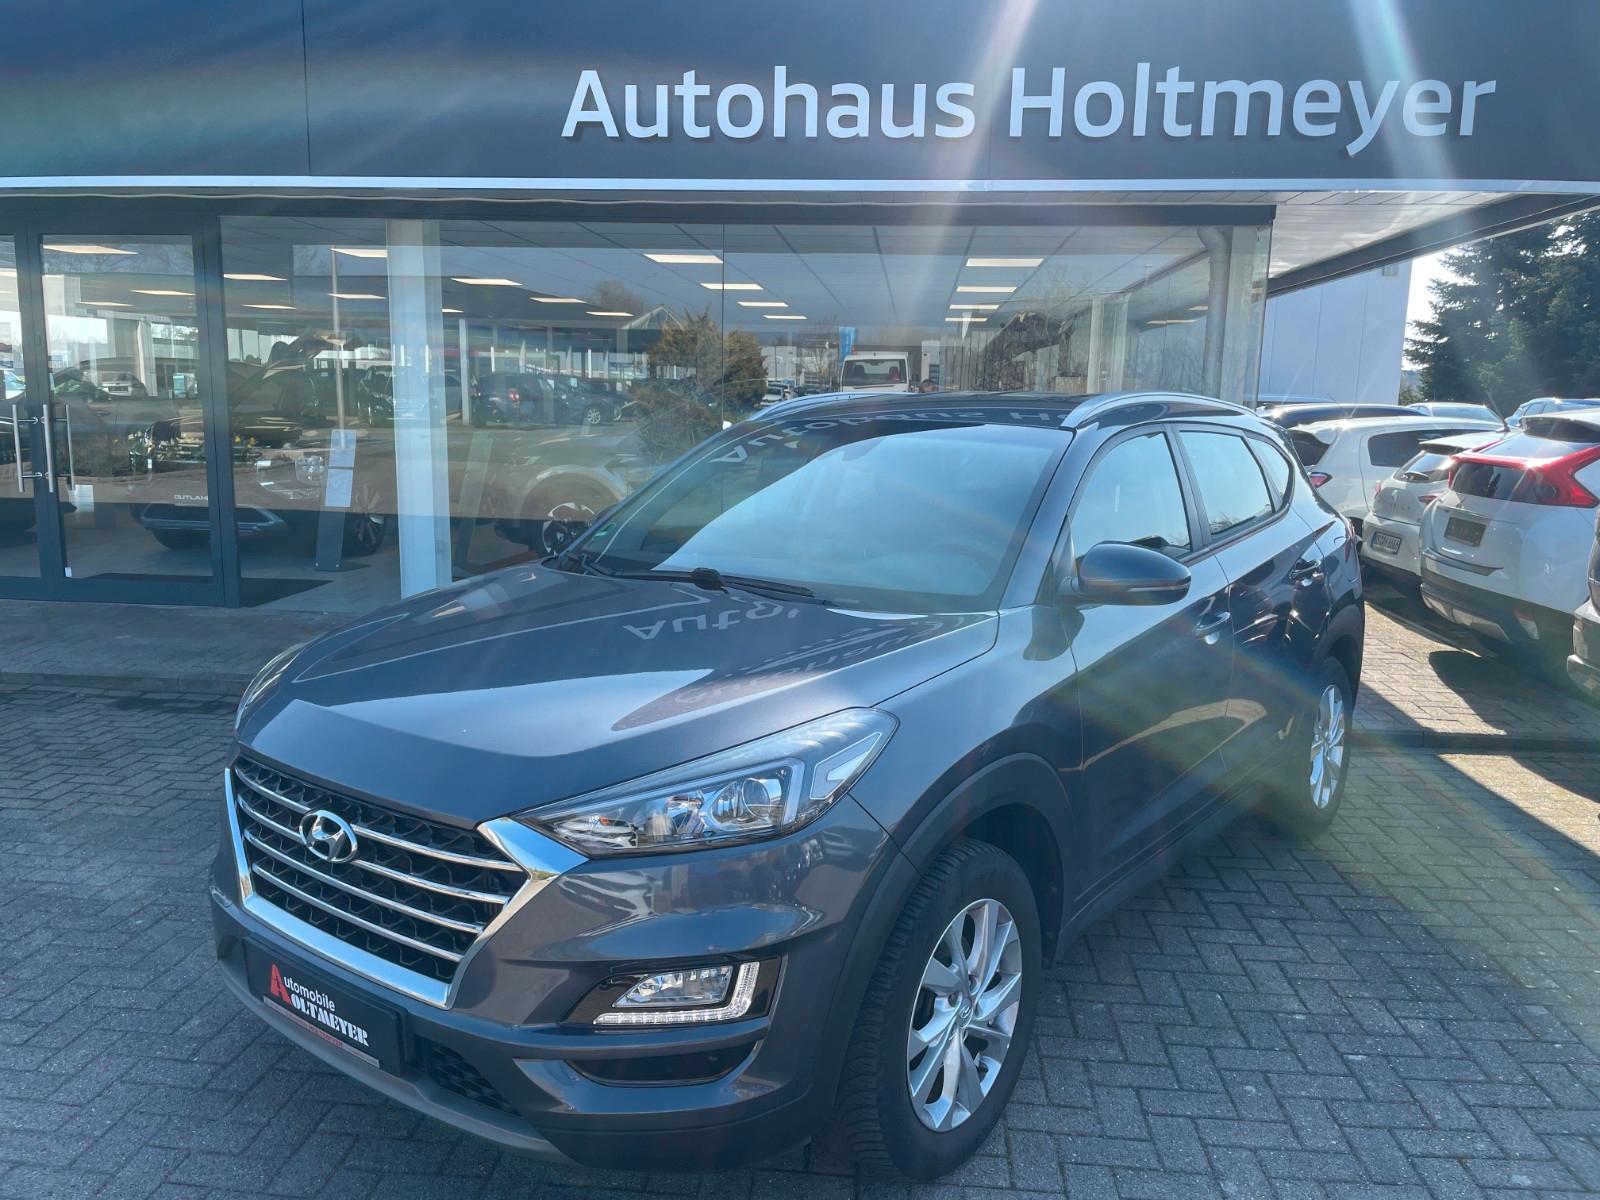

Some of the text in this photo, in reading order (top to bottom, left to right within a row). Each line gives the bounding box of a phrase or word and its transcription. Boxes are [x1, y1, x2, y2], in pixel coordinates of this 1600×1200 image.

[561, 61, 1497, 157] Autohaus Holtmeyer
[270, 963, 336, 1011] Automobile
